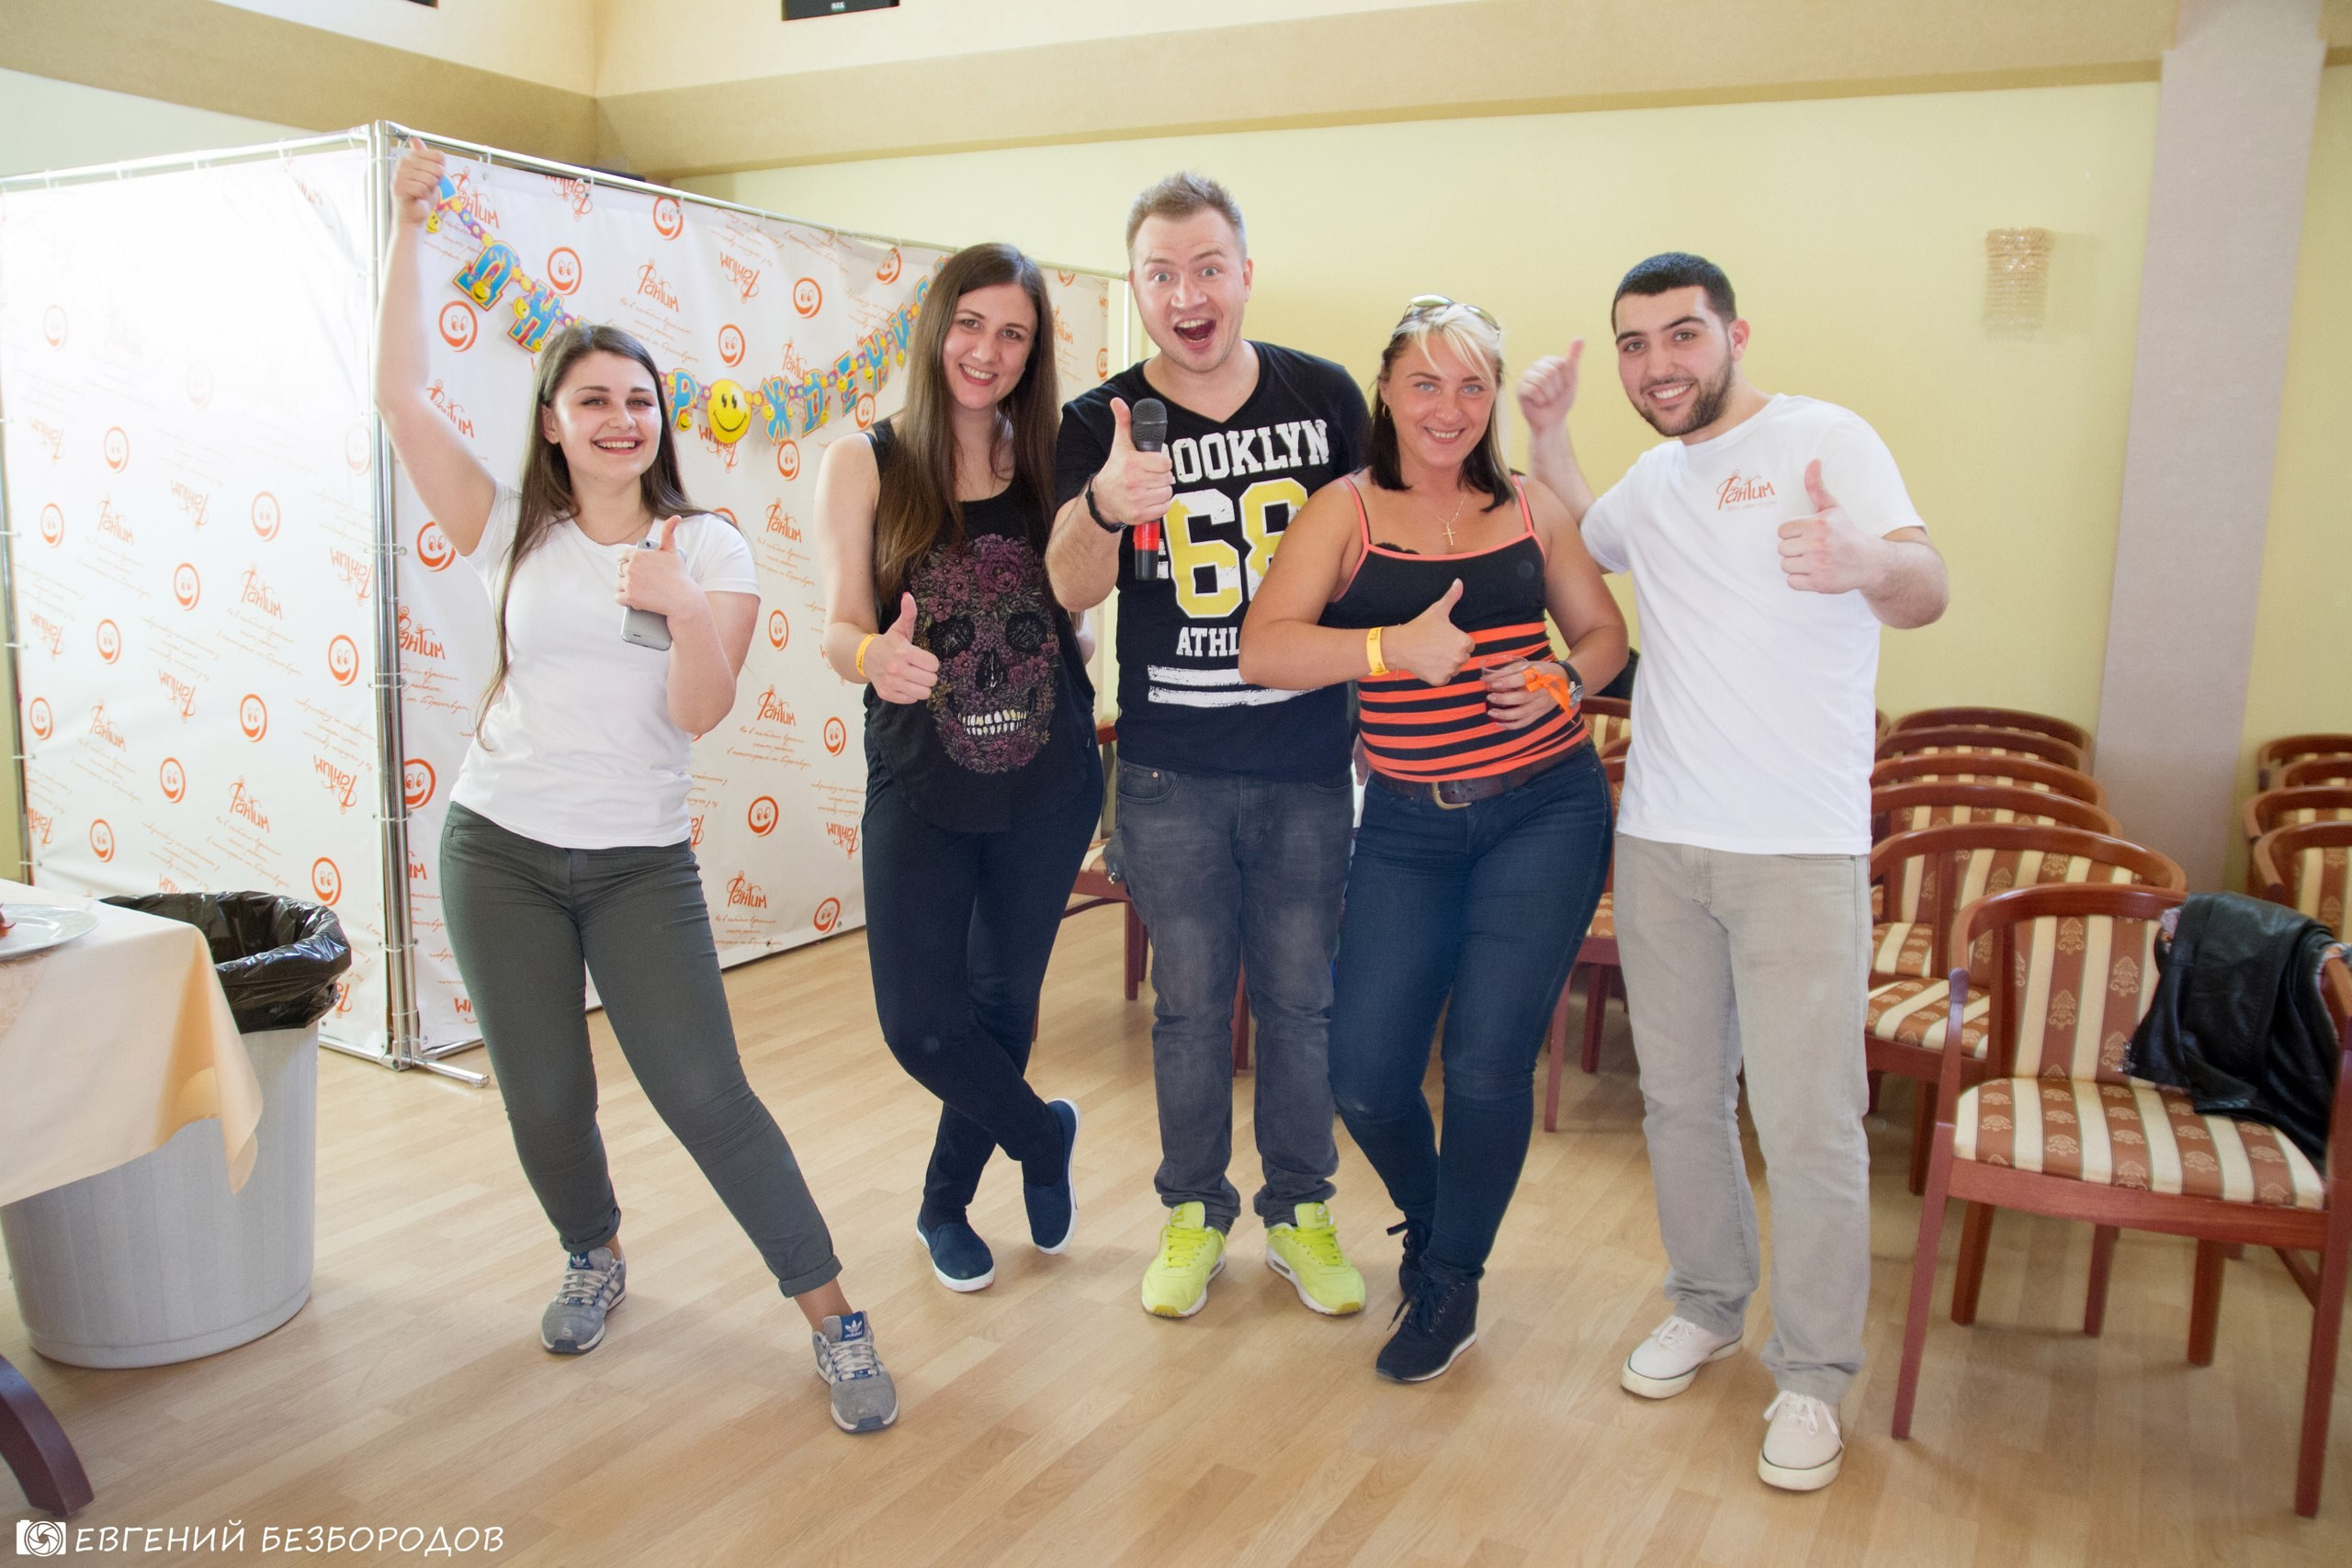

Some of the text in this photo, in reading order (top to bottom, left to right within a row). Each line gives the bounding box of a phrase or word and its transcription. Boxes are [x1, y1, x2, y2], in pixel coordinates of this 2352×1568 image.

[1161, 419, 1329, 484] OOKLYN
[1165, 477, 1308, 618] 68
[1176, 626, 1240, 657] ATHL
